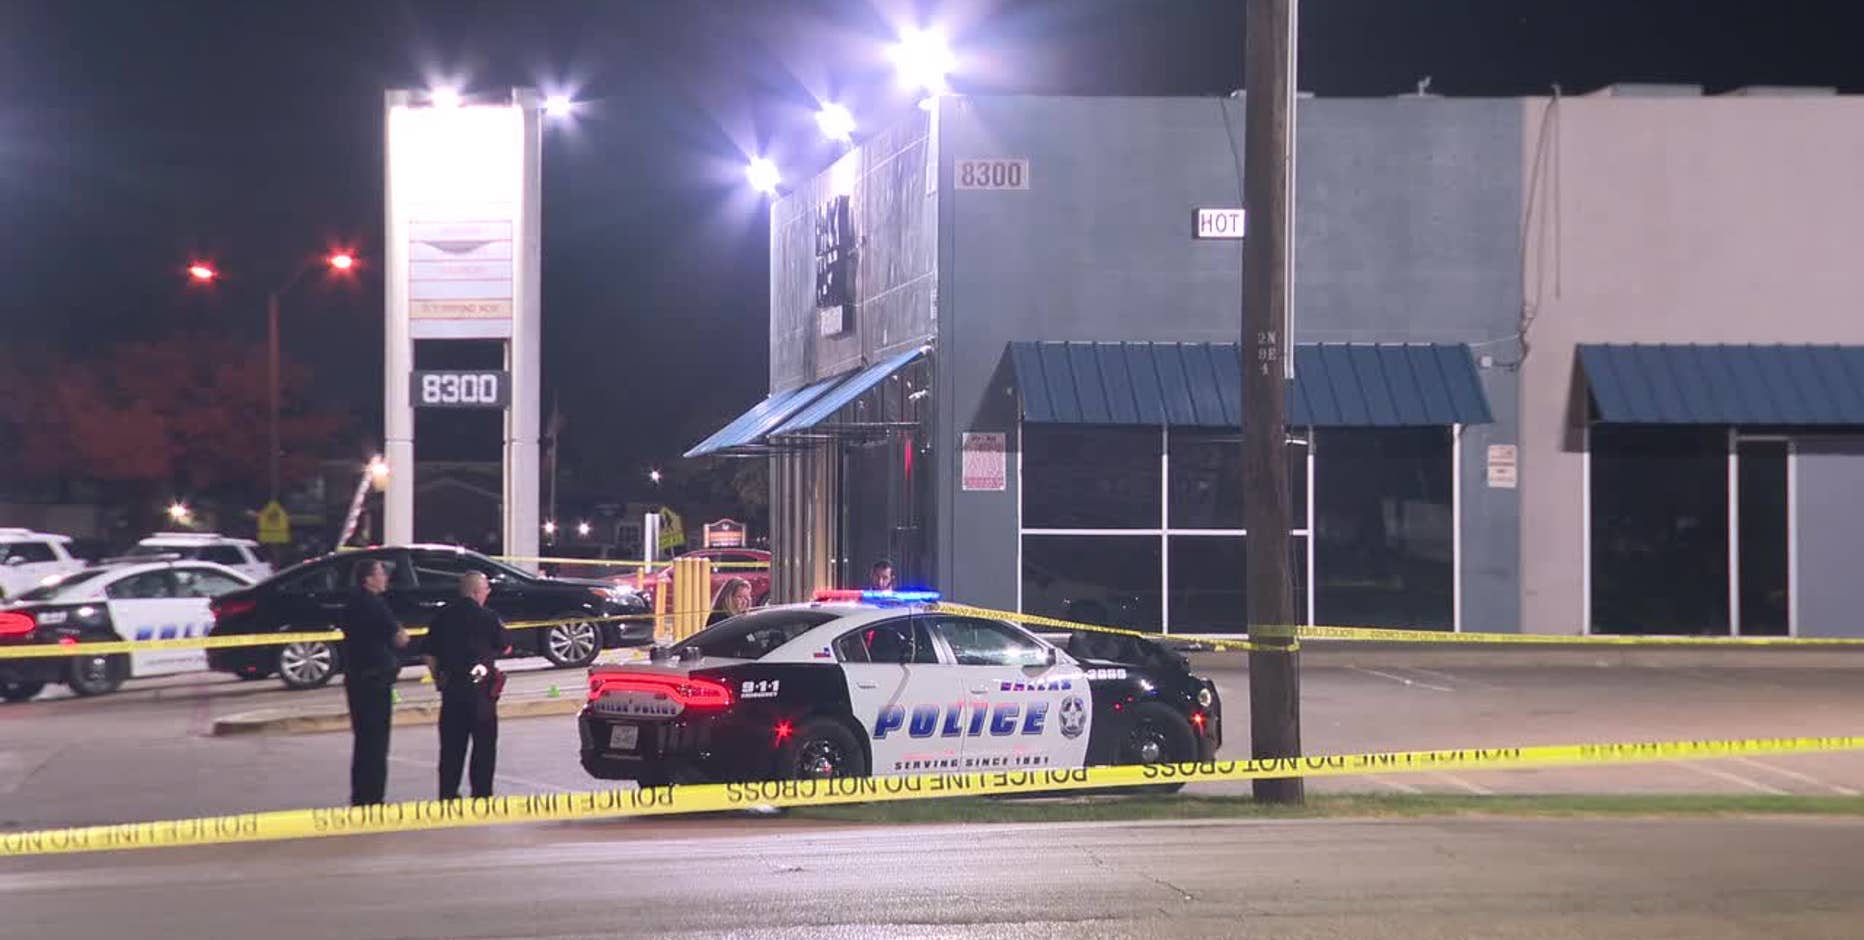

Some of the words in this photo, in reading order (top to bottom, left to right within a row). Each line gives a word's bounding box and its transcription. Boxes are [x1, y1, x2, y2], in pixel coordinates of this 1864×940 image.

[960, 162, 1022, 187] 8300
[1200, 213, 1240, 234] HOT
[422, 373, 498, 404] 8300
[872, 700, 1049, 740] POLICE
[894, 758, 959, 771] SERVING
[965, 757, 1008, 767] SINCE
[1143, 760, 1235, 779] CROSS
[1243, 757, 1298, 773] NOT
[823, 777, 877, 796] NOT
[884, 775, 921, 794] DO
[930, 772, 985, 791] LINE
[993, 767, 1088, 788] POLICE
[581, 784, 673, 810] POLICE
[726, 780, 817, 803] CROSS
[471, 796, 509, 820] DO
